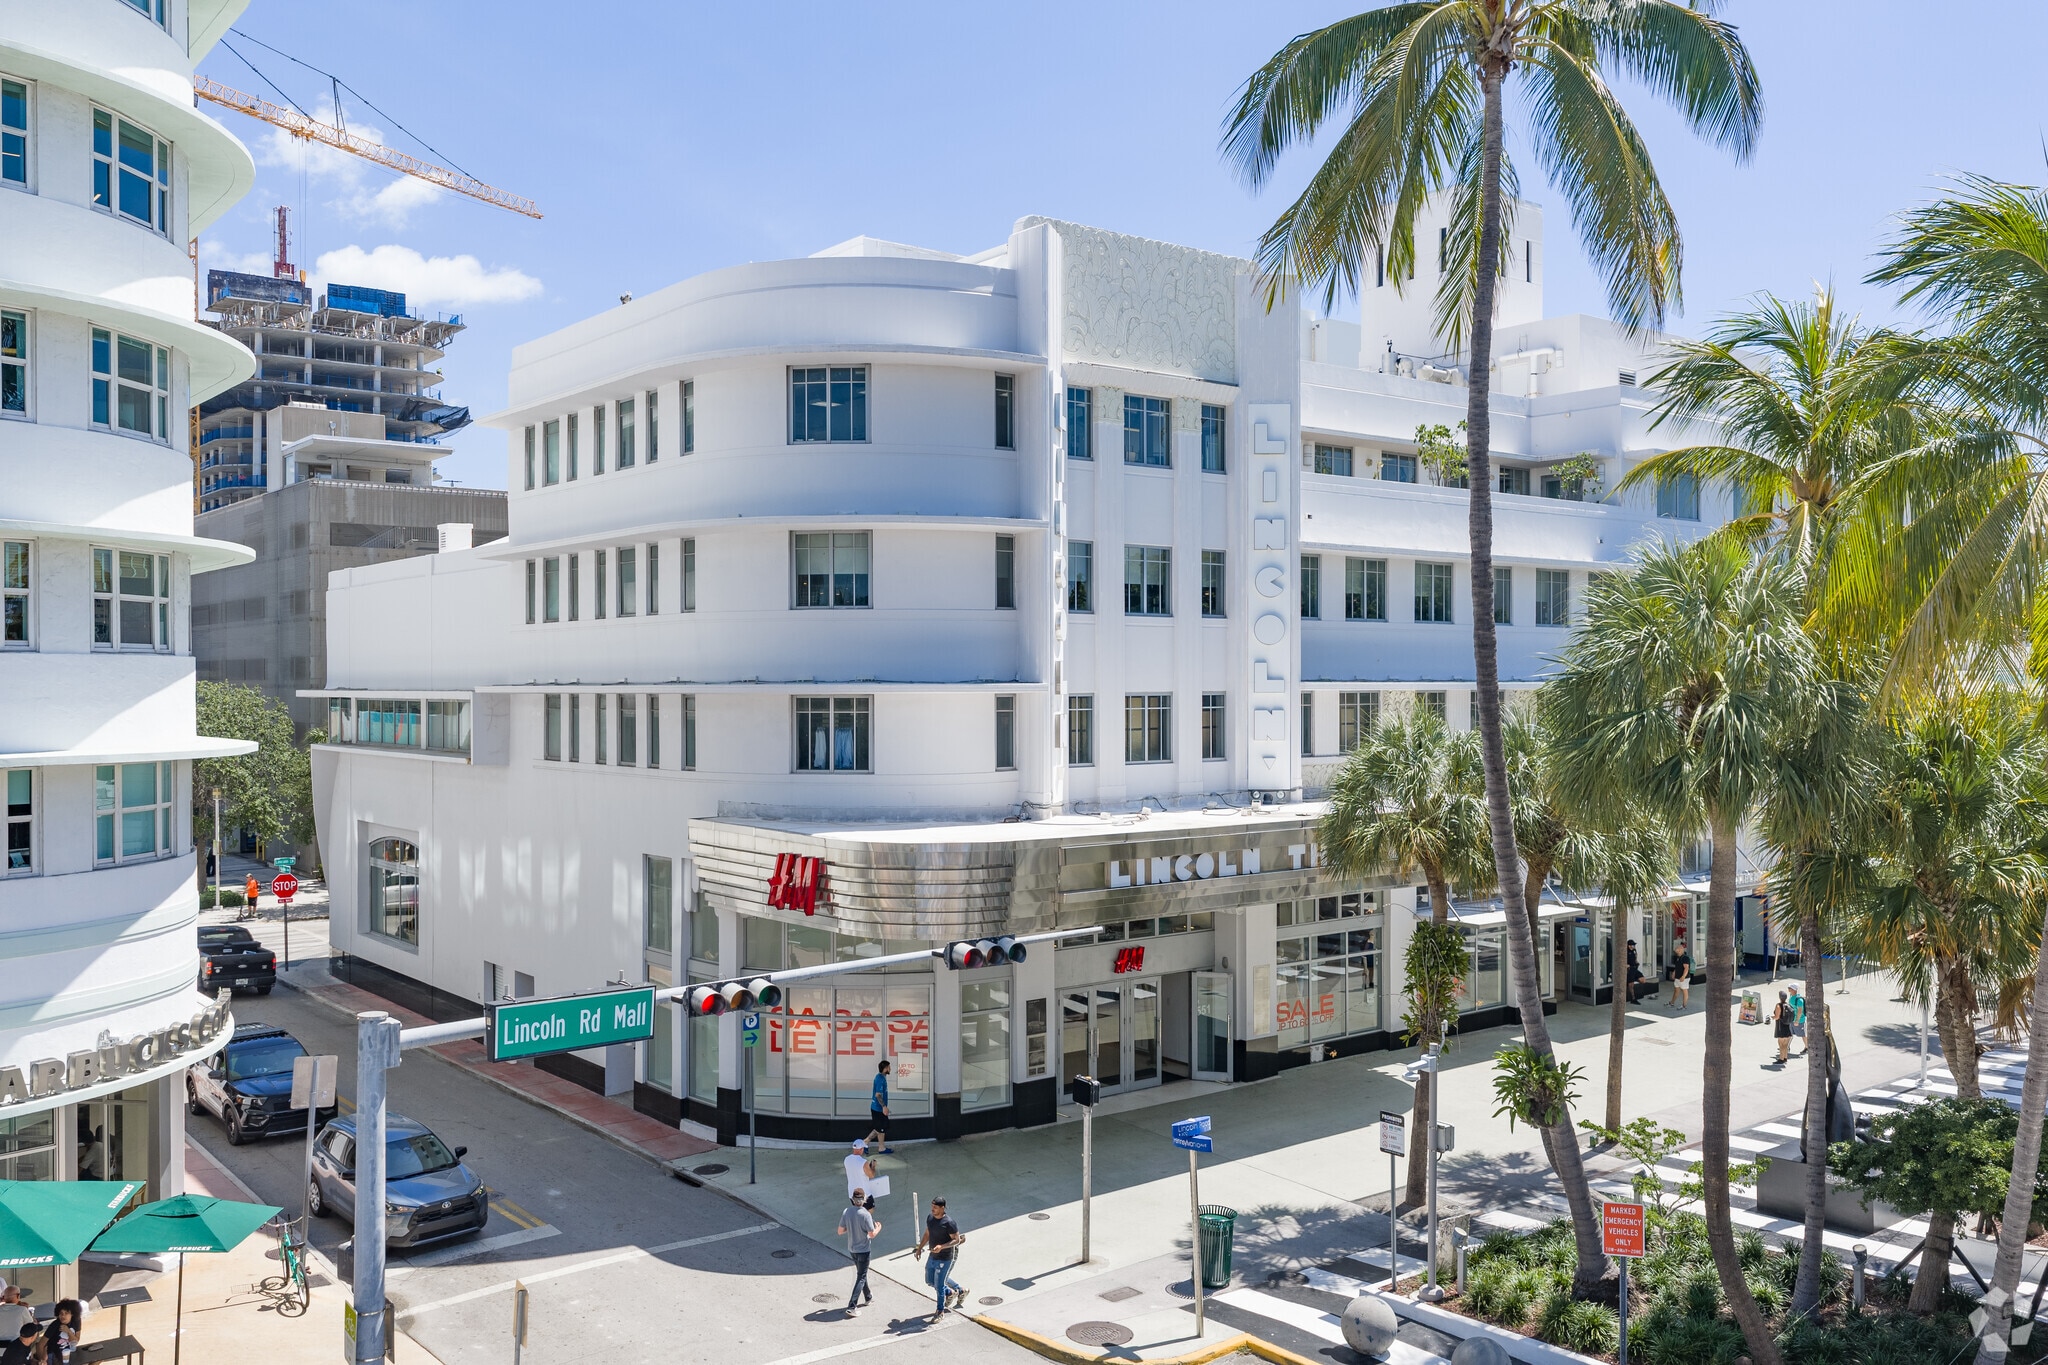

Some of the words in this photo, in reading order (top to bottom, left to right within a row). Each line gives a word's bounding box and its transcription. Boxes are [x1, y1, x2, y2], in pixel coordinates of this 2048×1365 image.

[1110, 848, 1261, 888] LINCOLN
[274, 881, 296, 891] STOP
[1276, 994, 1334, 1023] SALE
[503, 1013, 566, 1046] Lincoln
[579, 1008, 601, 1035] Rd
[613, 1001, 647, 1030] Mall
[1611, 1207, 1636, 1215] MARKED
[1605, 1217, 1641, 1226] EMERGENCY
[1609, 1228, 1638, 1236] VEHICLES
[1615, 1238, 1632, 1246] ONLY
